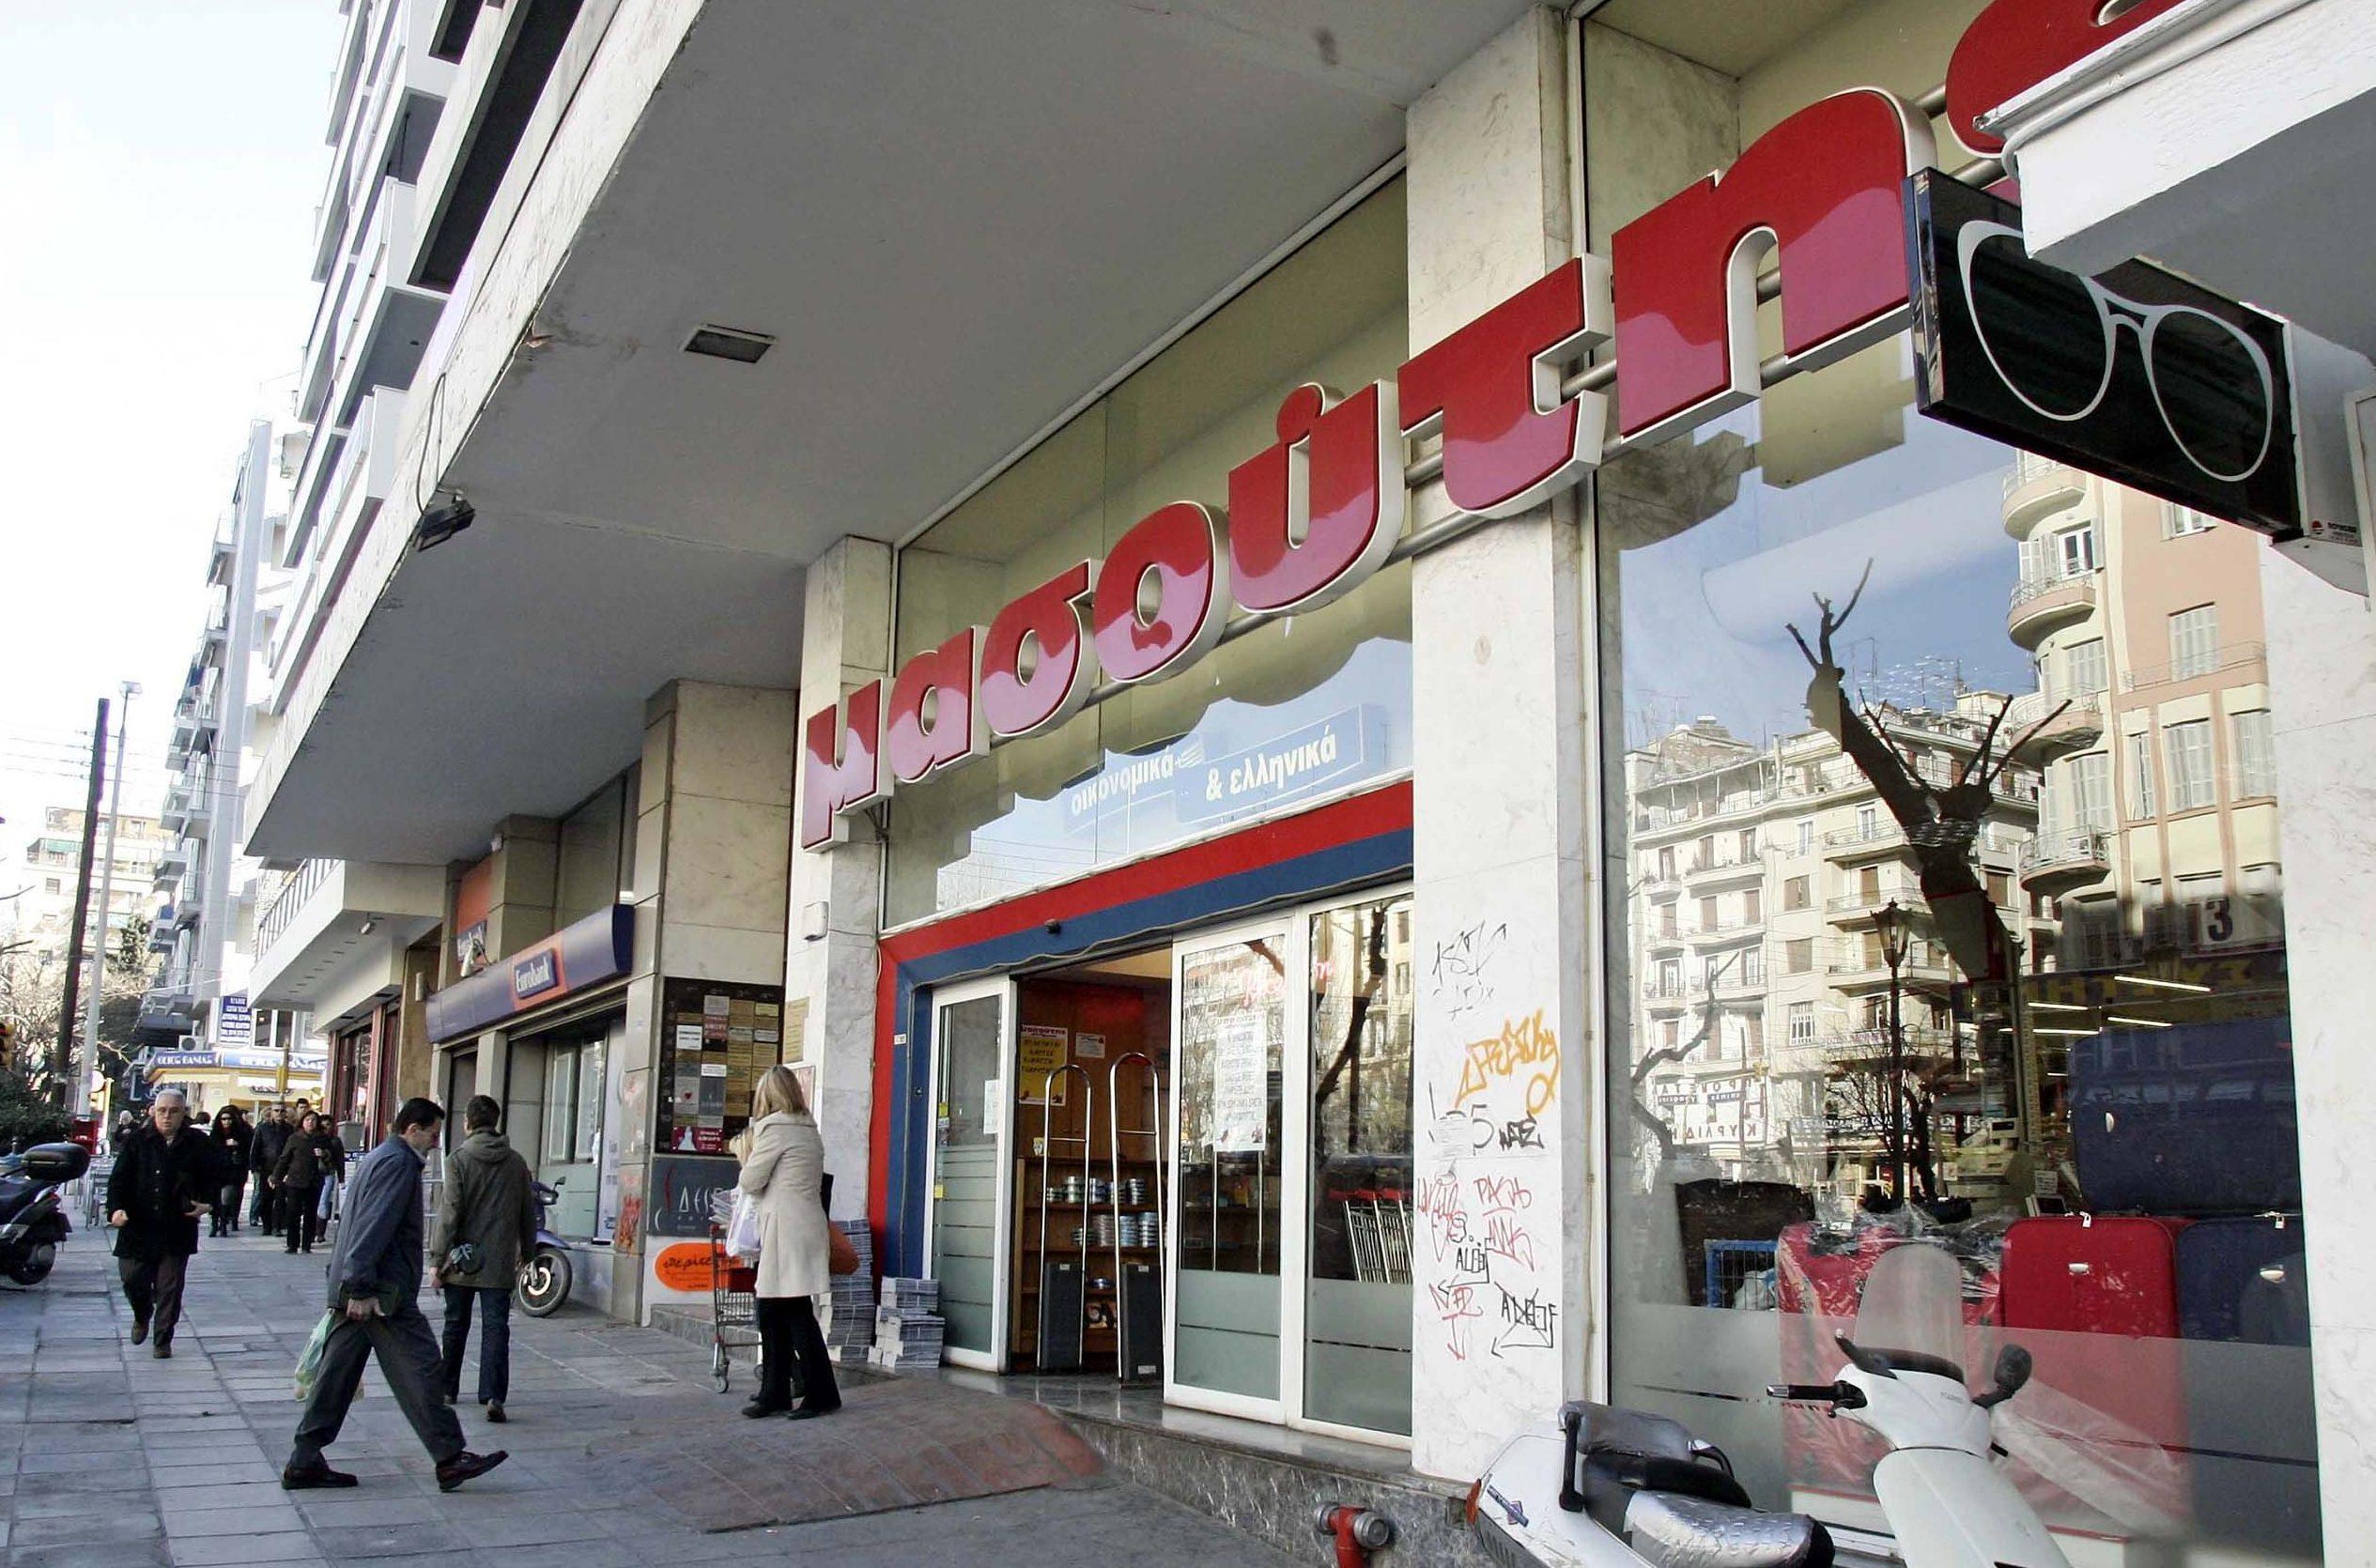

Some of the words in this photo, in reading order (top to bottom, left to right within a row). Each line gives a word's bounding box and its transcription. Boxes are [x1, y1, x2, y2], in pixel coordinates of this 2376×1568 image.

[1071, 745, 1175, 816] οικονομικά
[1205, 767, 1223, 802] &
[1229, 725, 1337, 795] ελληνικά
[516, 955, 550, 993] Eurobank
